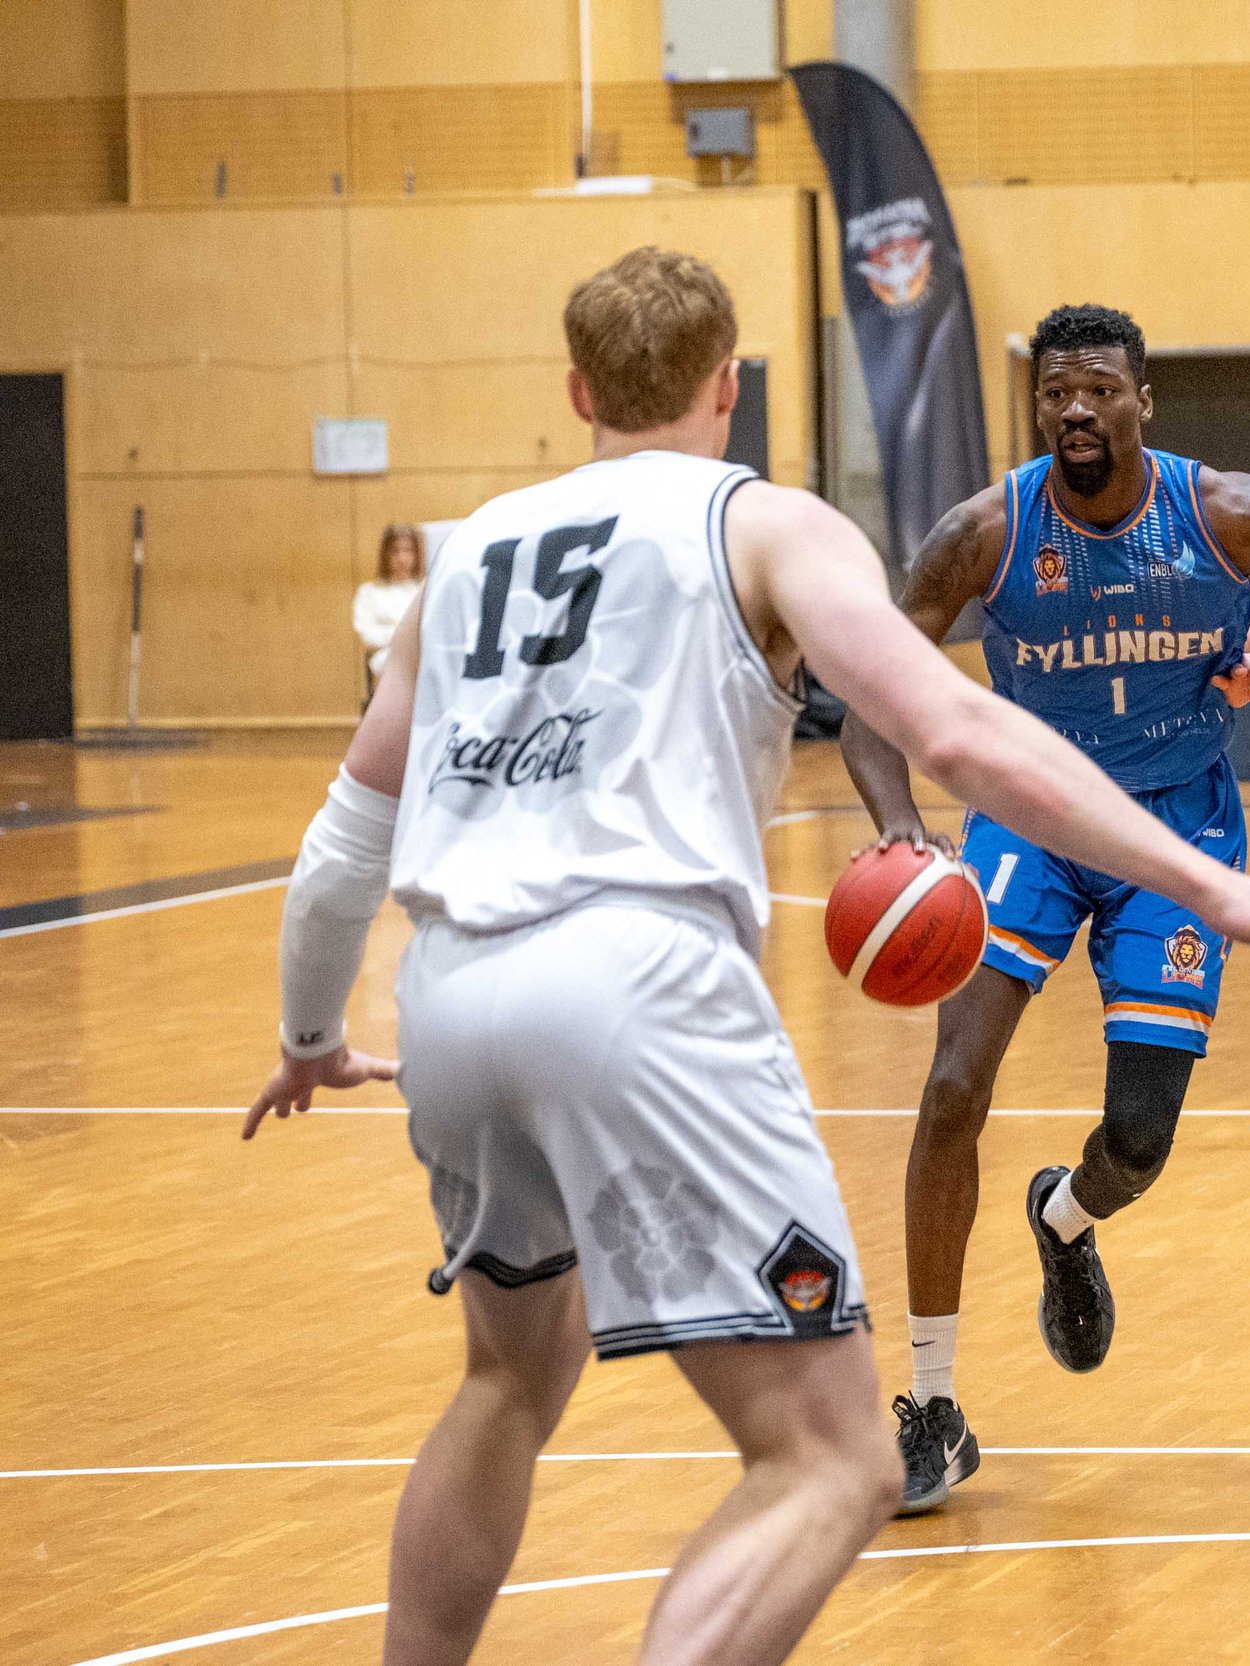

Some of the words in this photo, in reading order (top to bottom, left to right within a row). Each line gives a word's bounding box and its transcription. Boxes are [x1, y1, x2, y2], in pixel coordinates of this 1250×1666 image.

[1150, 563, 1173, 577] ENBL
[461, 514, 620, 680] 15
[1016, 627, 1224, 673] FYLLINGEN
[1110, 676, 1126, 715] 1
[986, 853, 1020, 904] 1
